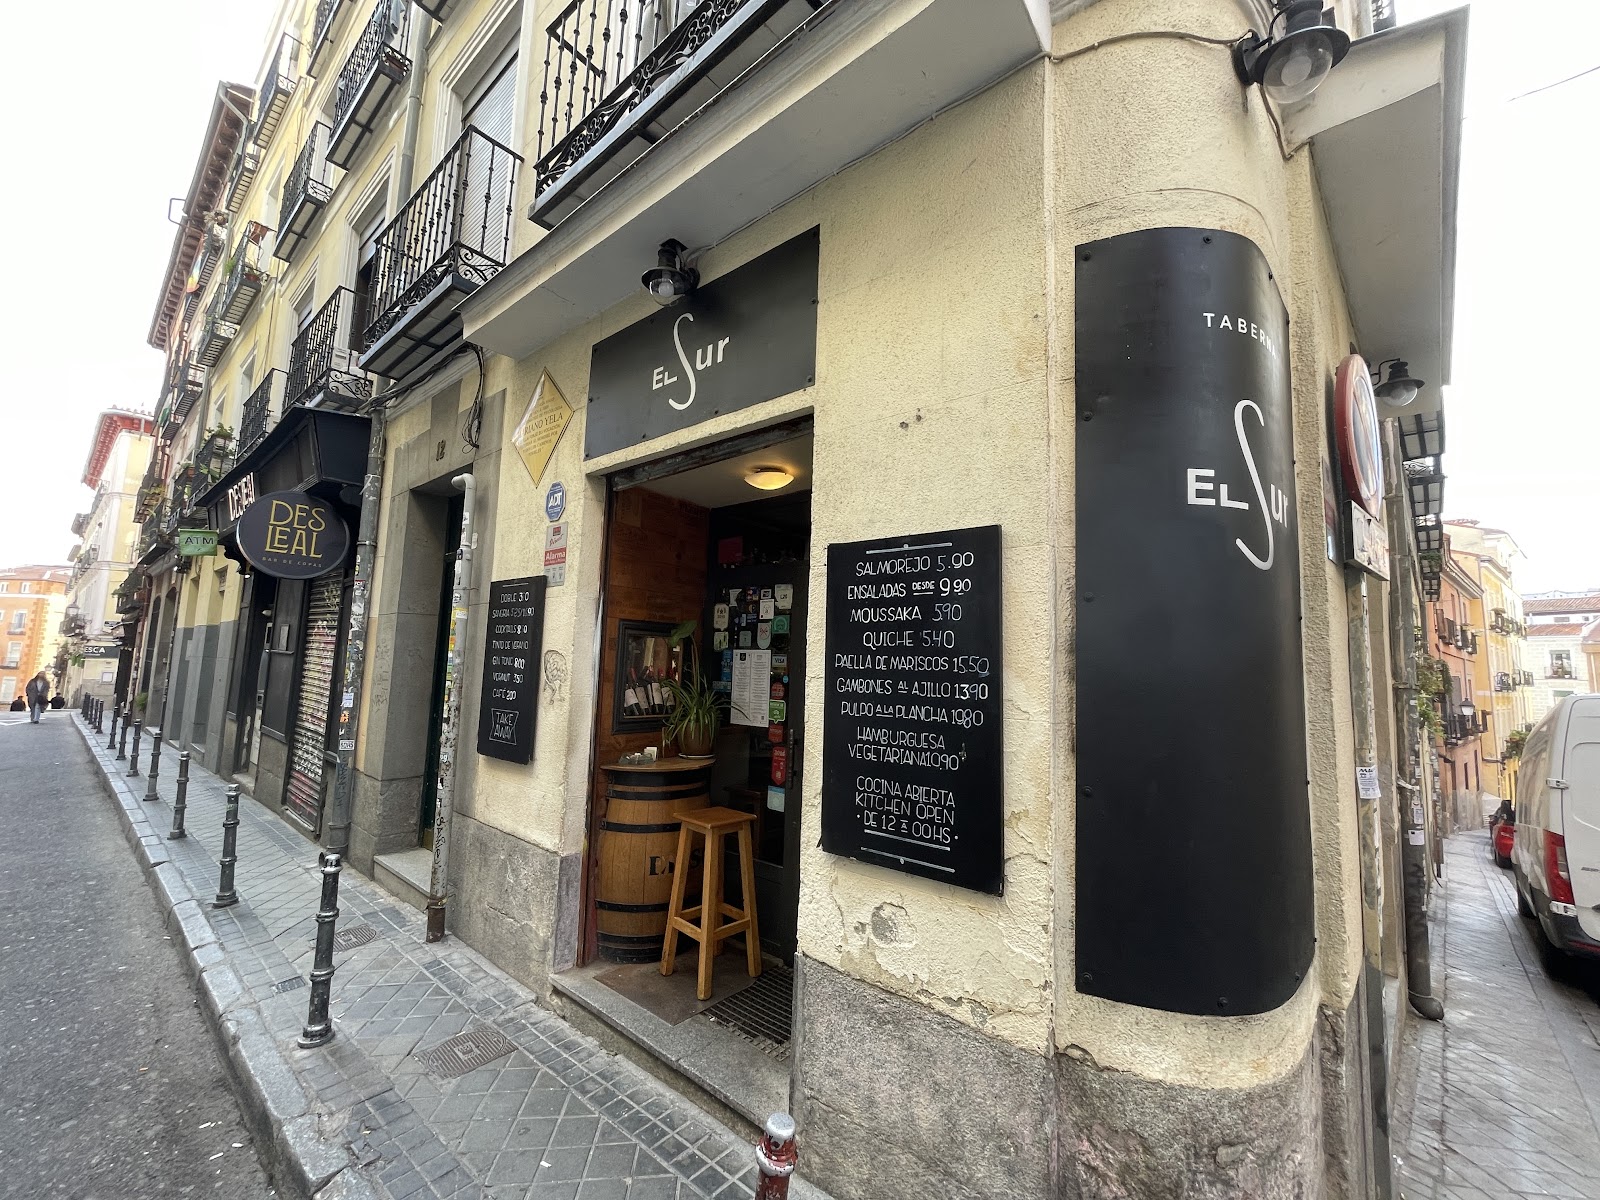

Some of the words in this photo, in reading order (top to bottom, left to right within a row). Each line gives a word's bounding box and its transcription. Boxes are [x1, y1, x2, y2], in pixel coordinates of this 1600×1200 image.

[1203, 312, 1277, 360] TABERNA
[653, 366, 678, 390] EL
[668, 312, 730, 410] Sur
[544, 412, 563, 426] YELA
[436, 440, 446, 461] 12
[1187, 468, 1249, 510] EL
[1234, 399, 1289, 571] Sur
[548, 491, 563, 507] ADT
[269, 500, 326, 532] DES
[184, 536, 214, 545] ATM
[265, 525, 323, 558] LEAL
[297, 560, 322, 568] COPAS
[545, 550, 566, 561] Alarma
[856, 555, 931, 577] SALMOREJO
[936, 552, 974, 572] 5.90
[847, 582, 907, 600] ENSALADAS
[912, 580, 936, 591] DESDE
[850, 606, 922, 623] MOUSSAKA
[492, 640, 505, 649] TINTO
[505, 640, 511, 649] DE
[512, 640, 529, 650] VERANO
[863, 630, 914, 650] QUICHE
[492, 656, 501, 666] GIN
[501, 656, 514, 666] TONIC
[835, 654, 872, 669] PAELLA
[875, 655, 888, 670] DE
[889, 656, 949, 671] MARISCOS
[492, 672, 511, 682] VERMUT
[836, 677, 893, 695] GAMBONES
[898, 681, 909, 690] AL
[912, 681, 951, 697] AJILLO
[492, 687, 507, 699] CAFÉ
[495, 711, 514, 726] TAKE
[841, 701, 874, 717] PULPO
[883, 704, 894, 714] LA
[895, 705, 949, 723] PLANCHA
[493, 724, 514, 740] AWAY
[857, 726, 946, 750] HAMBURGUESA
[848, 743, 927, 766] VEGETARIANA
[856, 775, 902, 797] COCINA
[904, 783, 956, 808] ABIERTA
[855, 792, 911, 816] KITCHEN
[915, 803, 955, 825] OPEN
[864, 810, 878, 827] DE
[881, 815, 896, 830] 12
